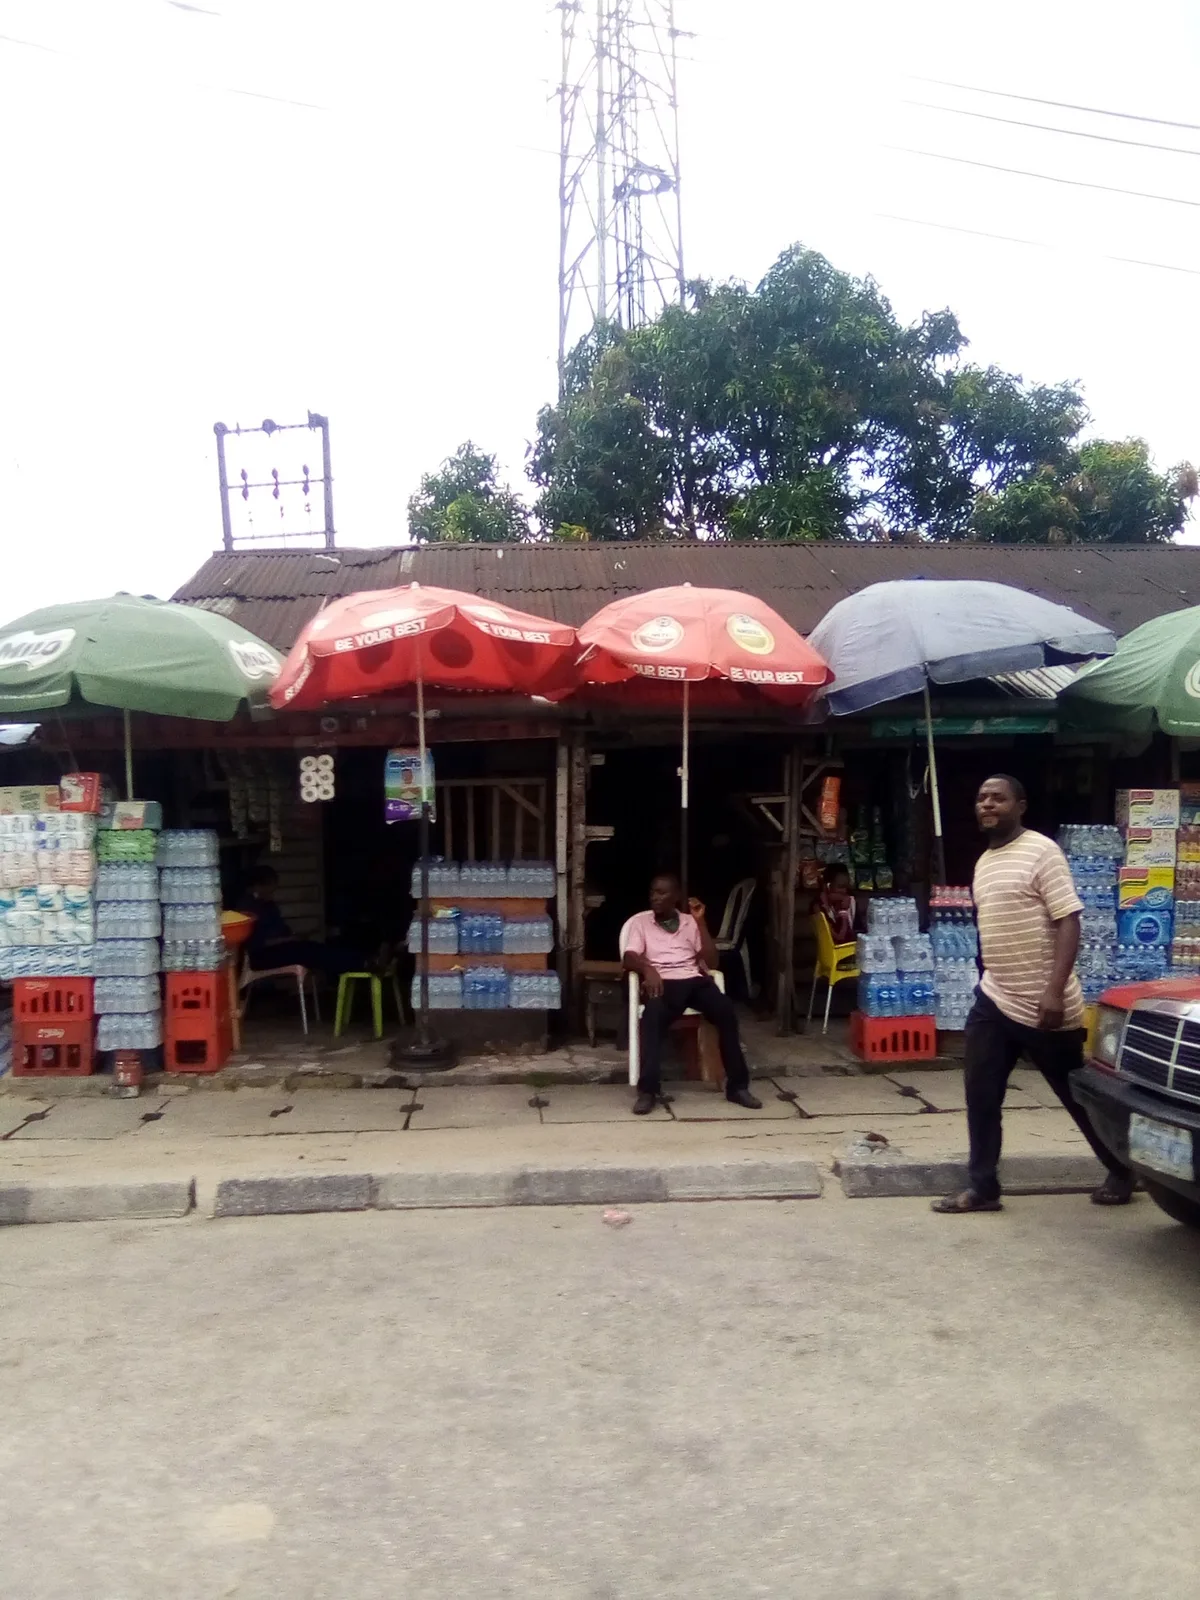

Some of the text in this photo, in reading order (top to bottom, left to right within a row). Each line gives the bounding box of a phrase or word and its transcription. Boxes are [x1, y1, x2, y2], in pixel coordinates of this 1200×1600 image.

[334, 617, 427, 651] BE YOUR BEST
[490, 624, 523, 641] YOUR
[523, 631, 551, 644] BEST
[0, 640, 62, 659] MILO
[657, 665, 687, 678] BEST
[730, 666, 804, 683] BE YOUR BEST
